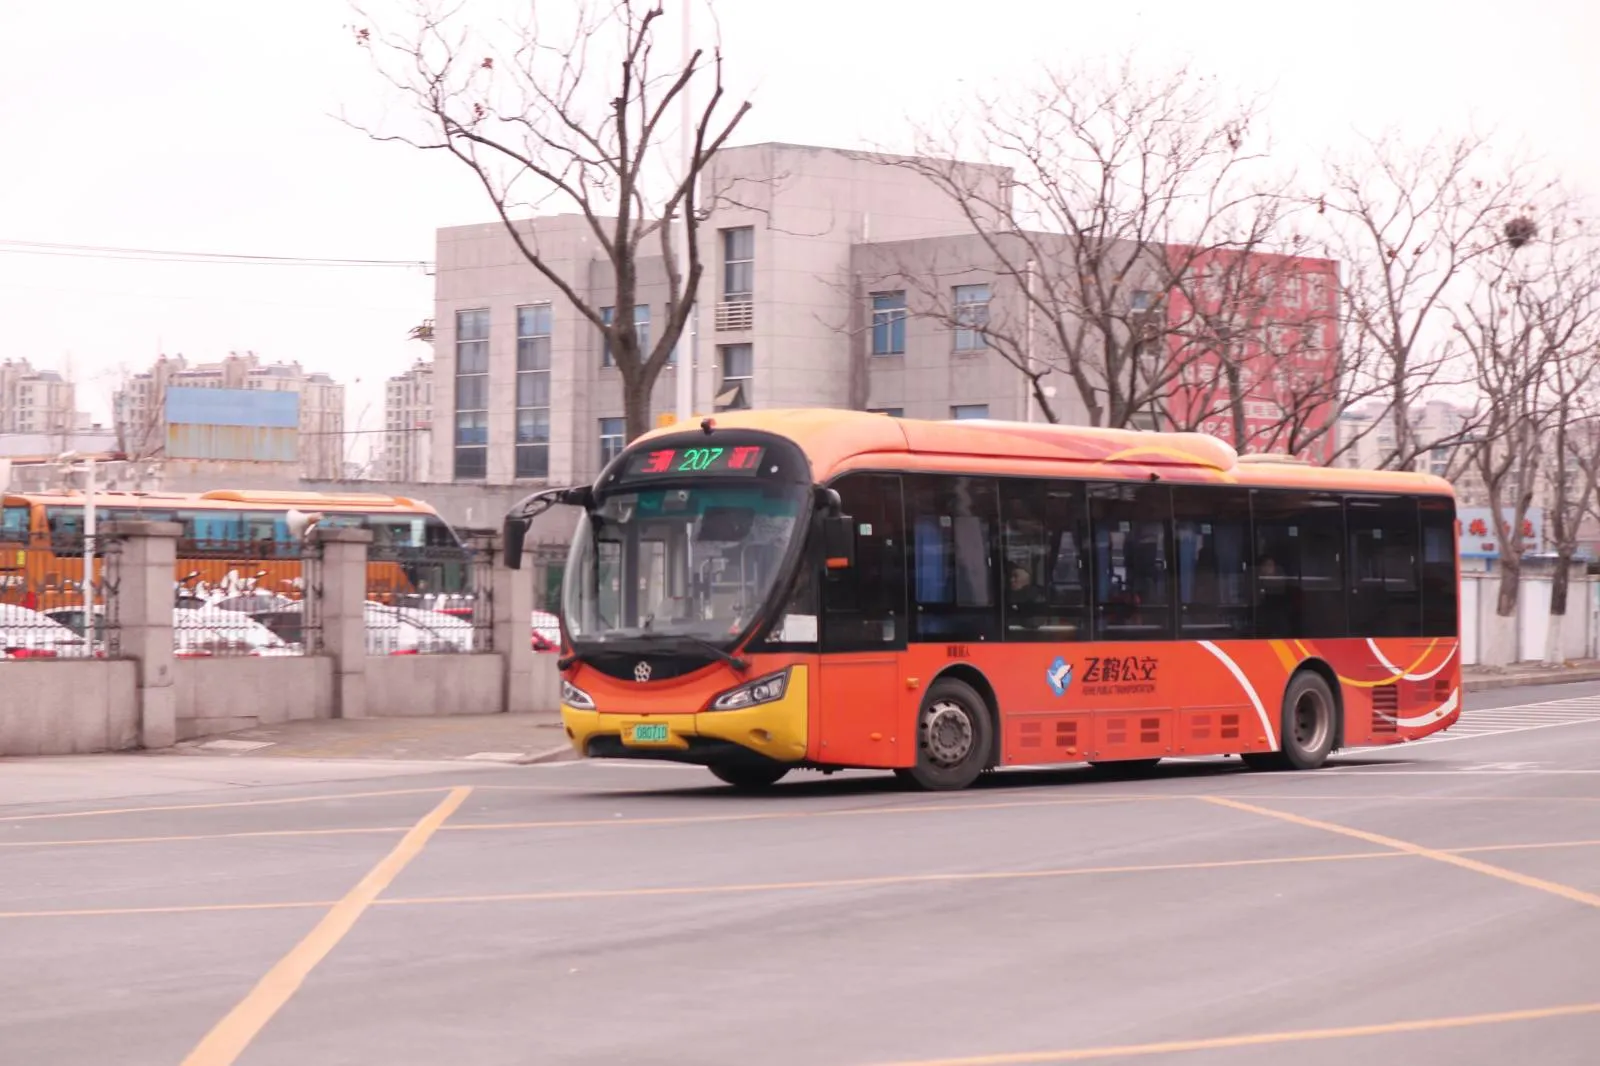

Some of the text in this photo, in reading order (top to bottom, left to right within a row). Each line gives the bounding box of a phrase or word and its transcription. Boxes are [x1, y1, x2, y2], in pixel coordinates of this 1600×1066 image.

[678, 447, 724, 471] 207
[1081, 656, 1158, 682] 飞鹤公交
